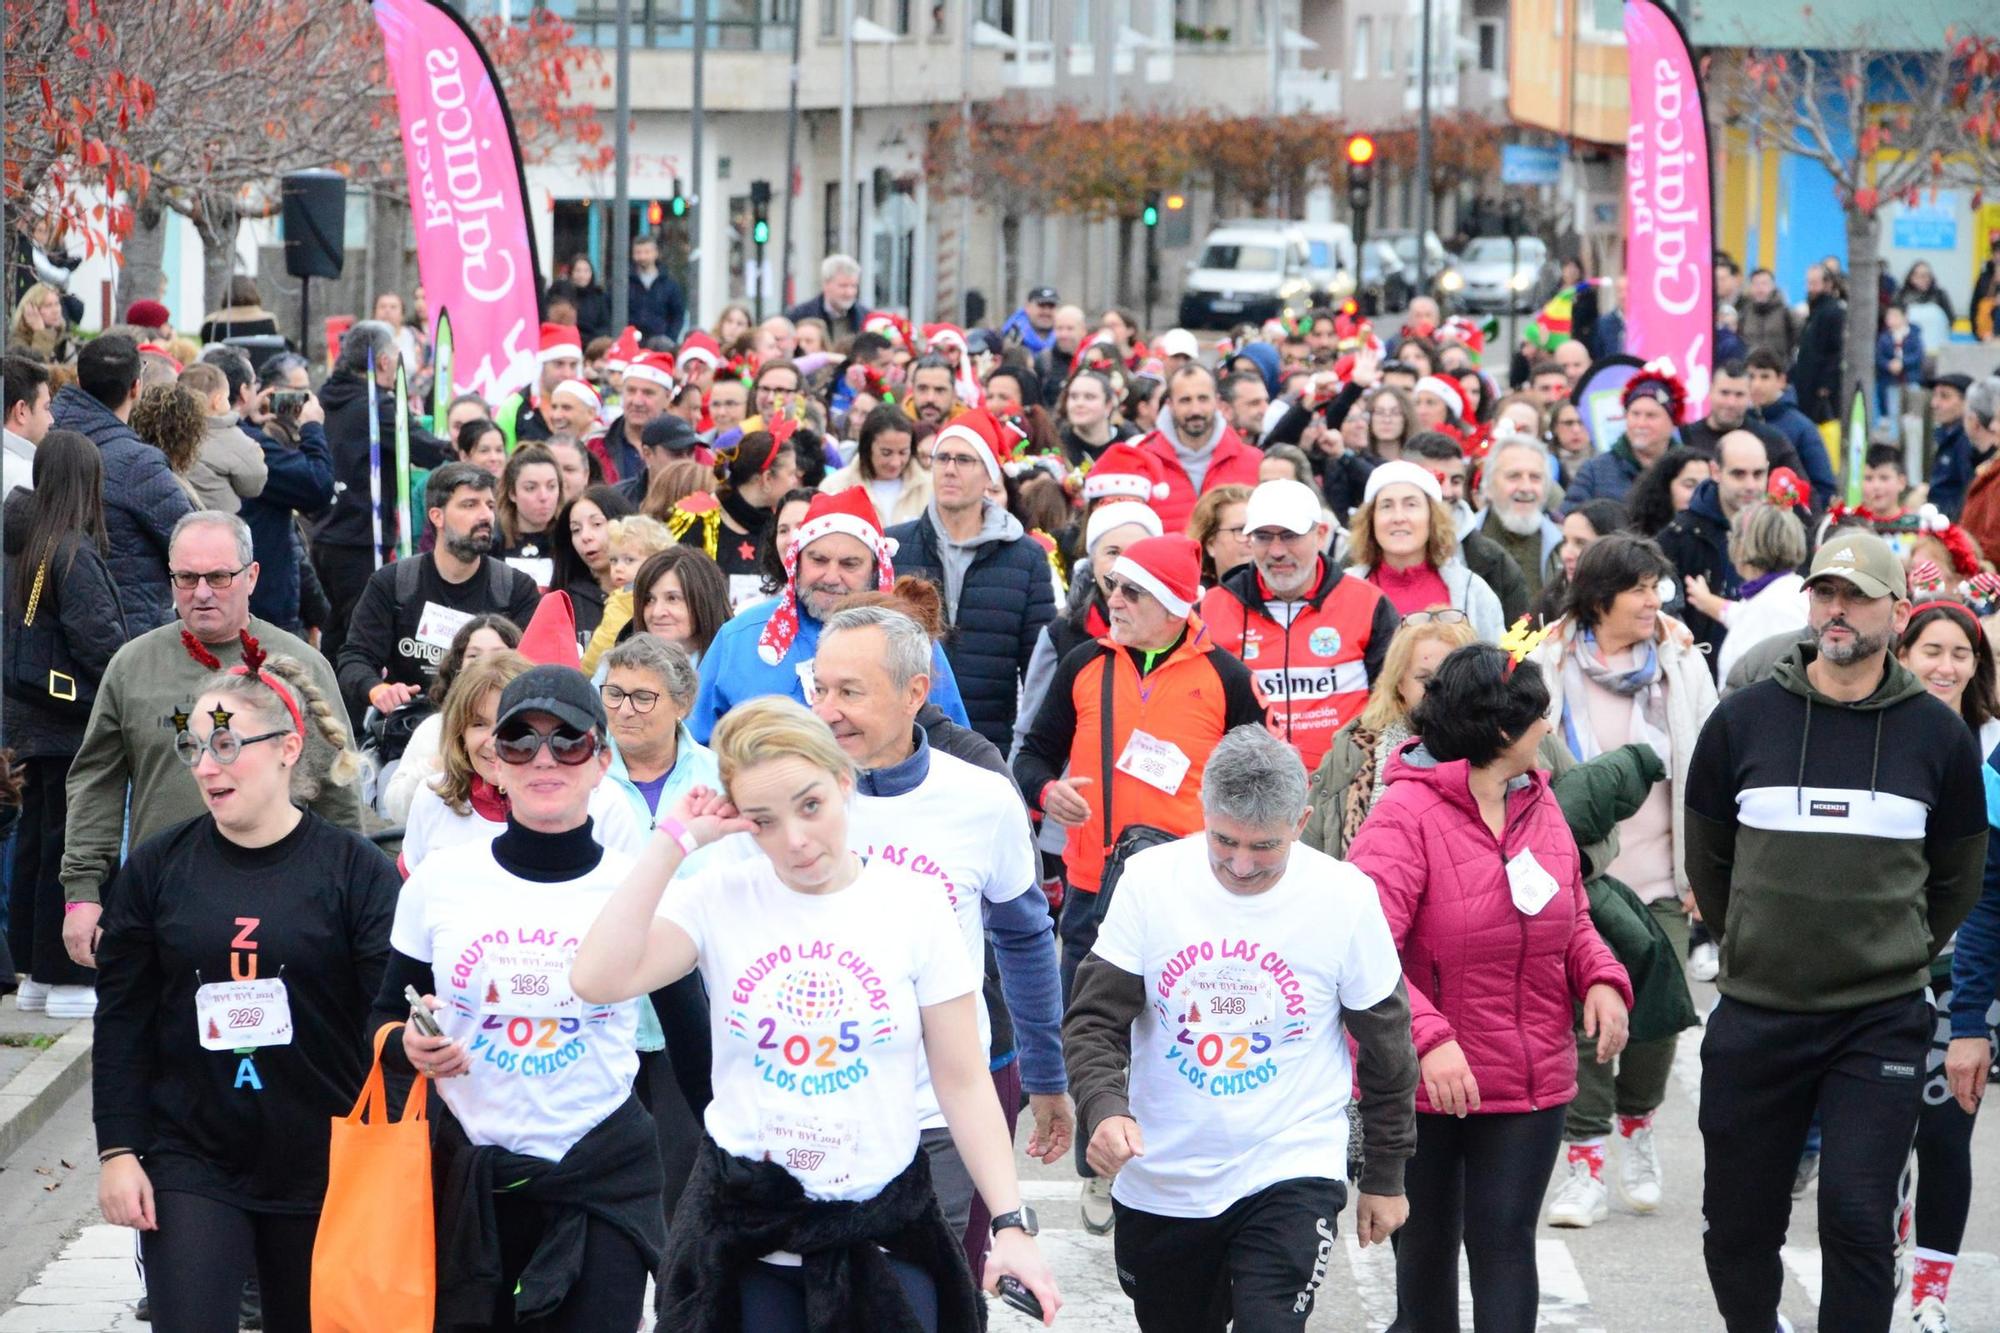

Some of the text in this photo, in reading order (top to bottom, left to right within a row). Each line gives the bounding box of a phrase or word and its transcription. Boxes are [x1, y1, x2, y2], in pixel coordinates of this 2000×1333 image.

[1258, 668, 1338, 696] simei
[518, 928, 558, 946] LAS
[510, 974, 550, 996] 136
[732, 940, 889, 1010] EQUIPO LAS CHICAS
[1158, 938, 1306, 1016] EQUIPO LAS CHICAS
[228, 1007, 264, 1029] 229
[231, 917, 263, 1089] ZUA
[1211, 996, 1246, 1014] 148
[484, 1044, 519, 1072] LOS
[521, 1037, 586, 1076] CHICOS
[758, 1017, 860, 1067] 2025
[763, 1064, 796, 1092] LOS
[801, 1058, 868, 1096] CHICOS
[1178, 1058, 1207, 1089] LOS
[1210, 1058, 1277, 1096] CHICOS
[786, 1148, 825, 1171] 137
